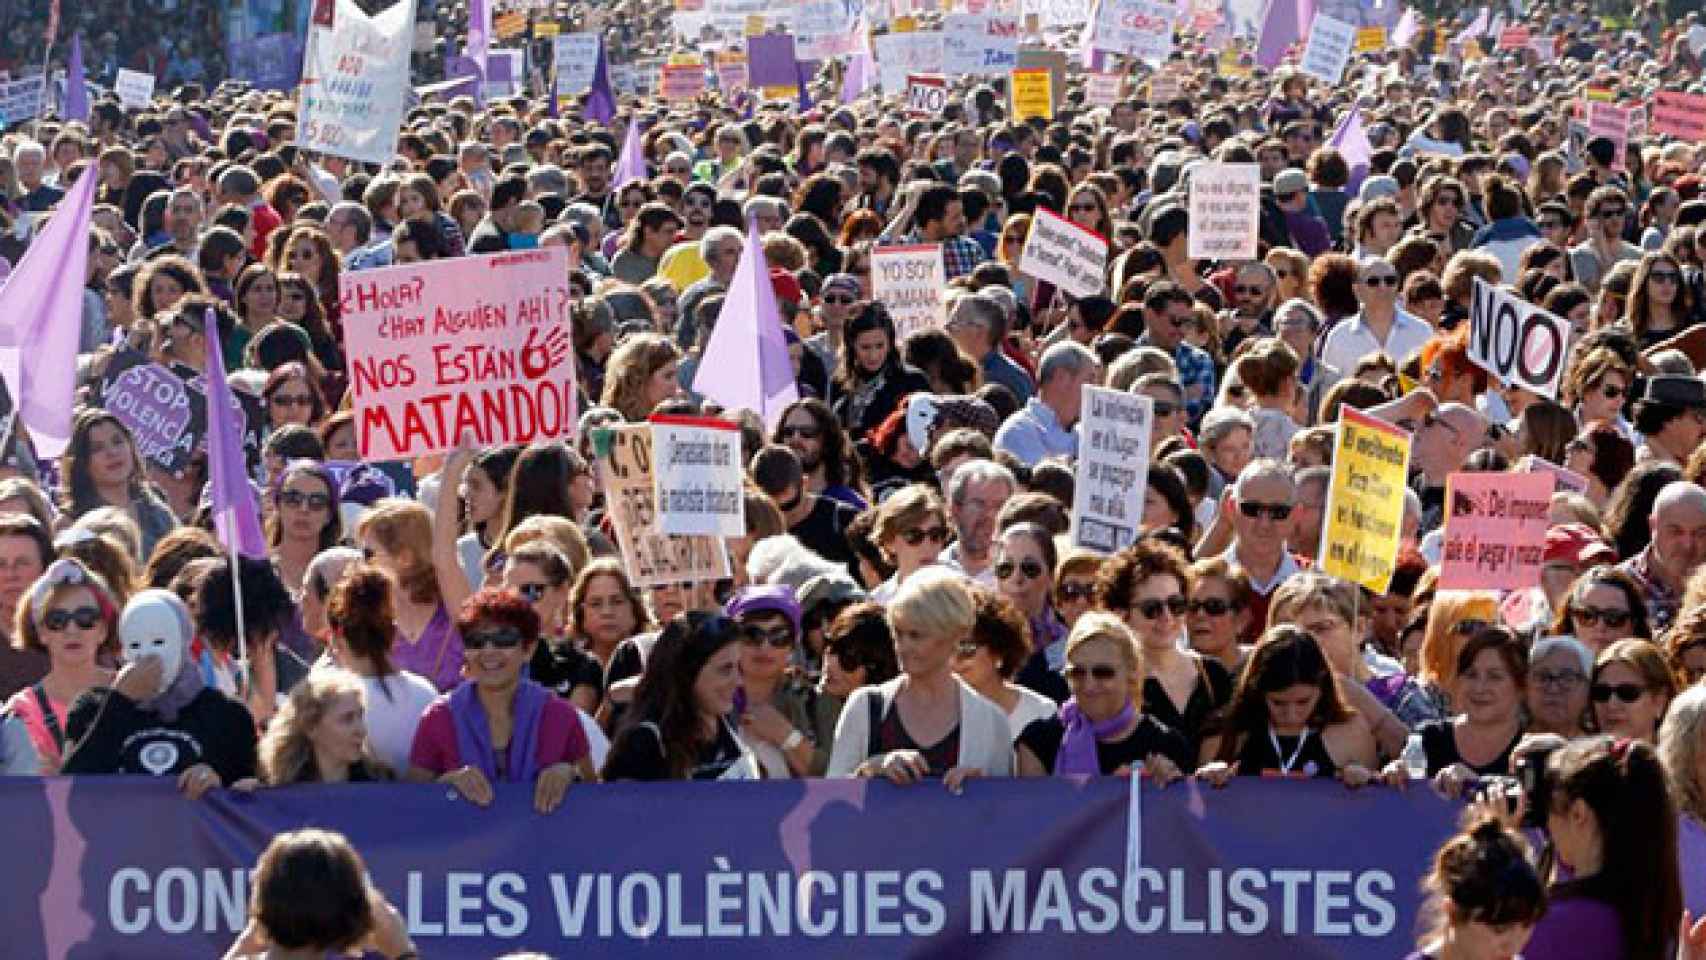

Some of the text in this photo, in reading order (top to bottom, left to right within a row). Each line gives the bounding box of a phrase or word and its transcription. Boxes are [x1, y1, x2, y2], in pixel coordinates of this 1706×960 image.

[911, 86, 944, 112] NO
[124, 365, 190, 410] STOP
[352, 353, 417, 396] NOS
[361, 379, 572, 456] MATANDO!
[407, 870, 529, 938] LES
[549, 855, 947, 938] VIOLÈNCIES
[969, 866, 1397, 937] MASCLISTES
